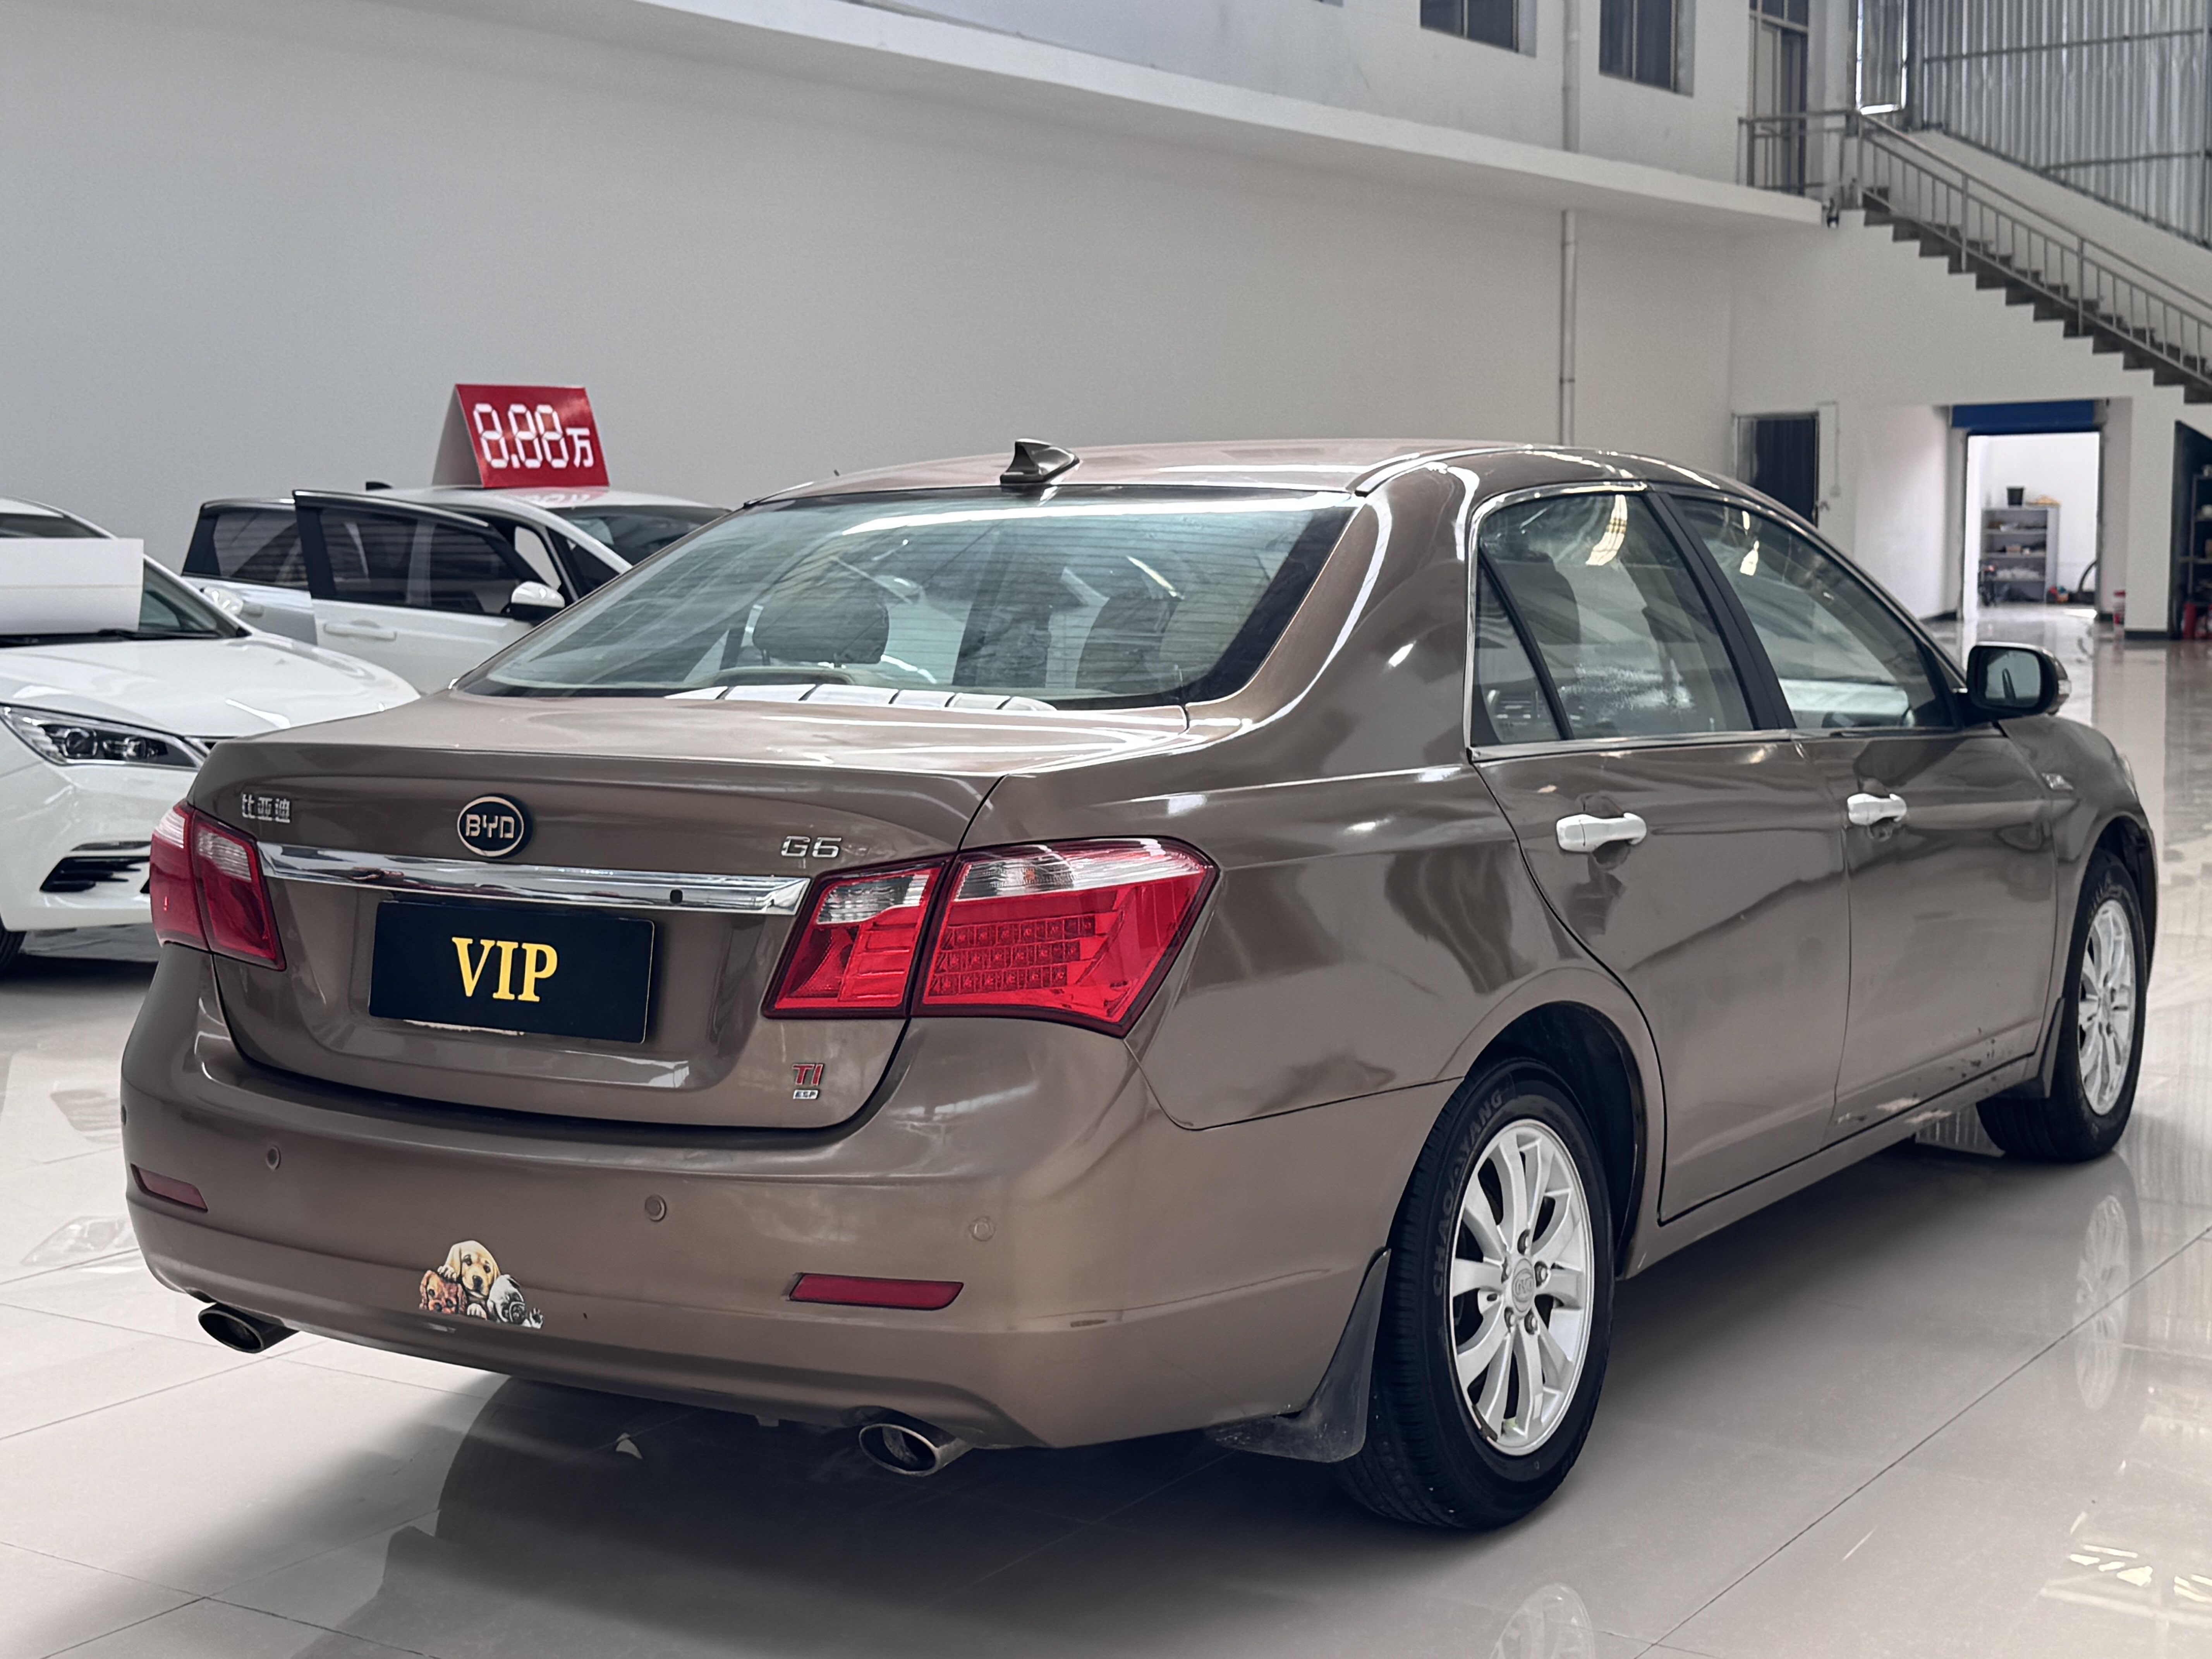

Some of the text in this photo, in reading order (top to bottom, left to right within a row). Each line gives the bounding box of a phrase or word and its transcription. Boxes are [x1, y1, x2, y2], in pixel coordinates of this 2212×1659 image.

[242, 794, 290, 823] 比亚迪
[466, 814, 515, 838] BYD
[781, 836, 842, 858] G6
[452, 937, 558, 1002] VIP
